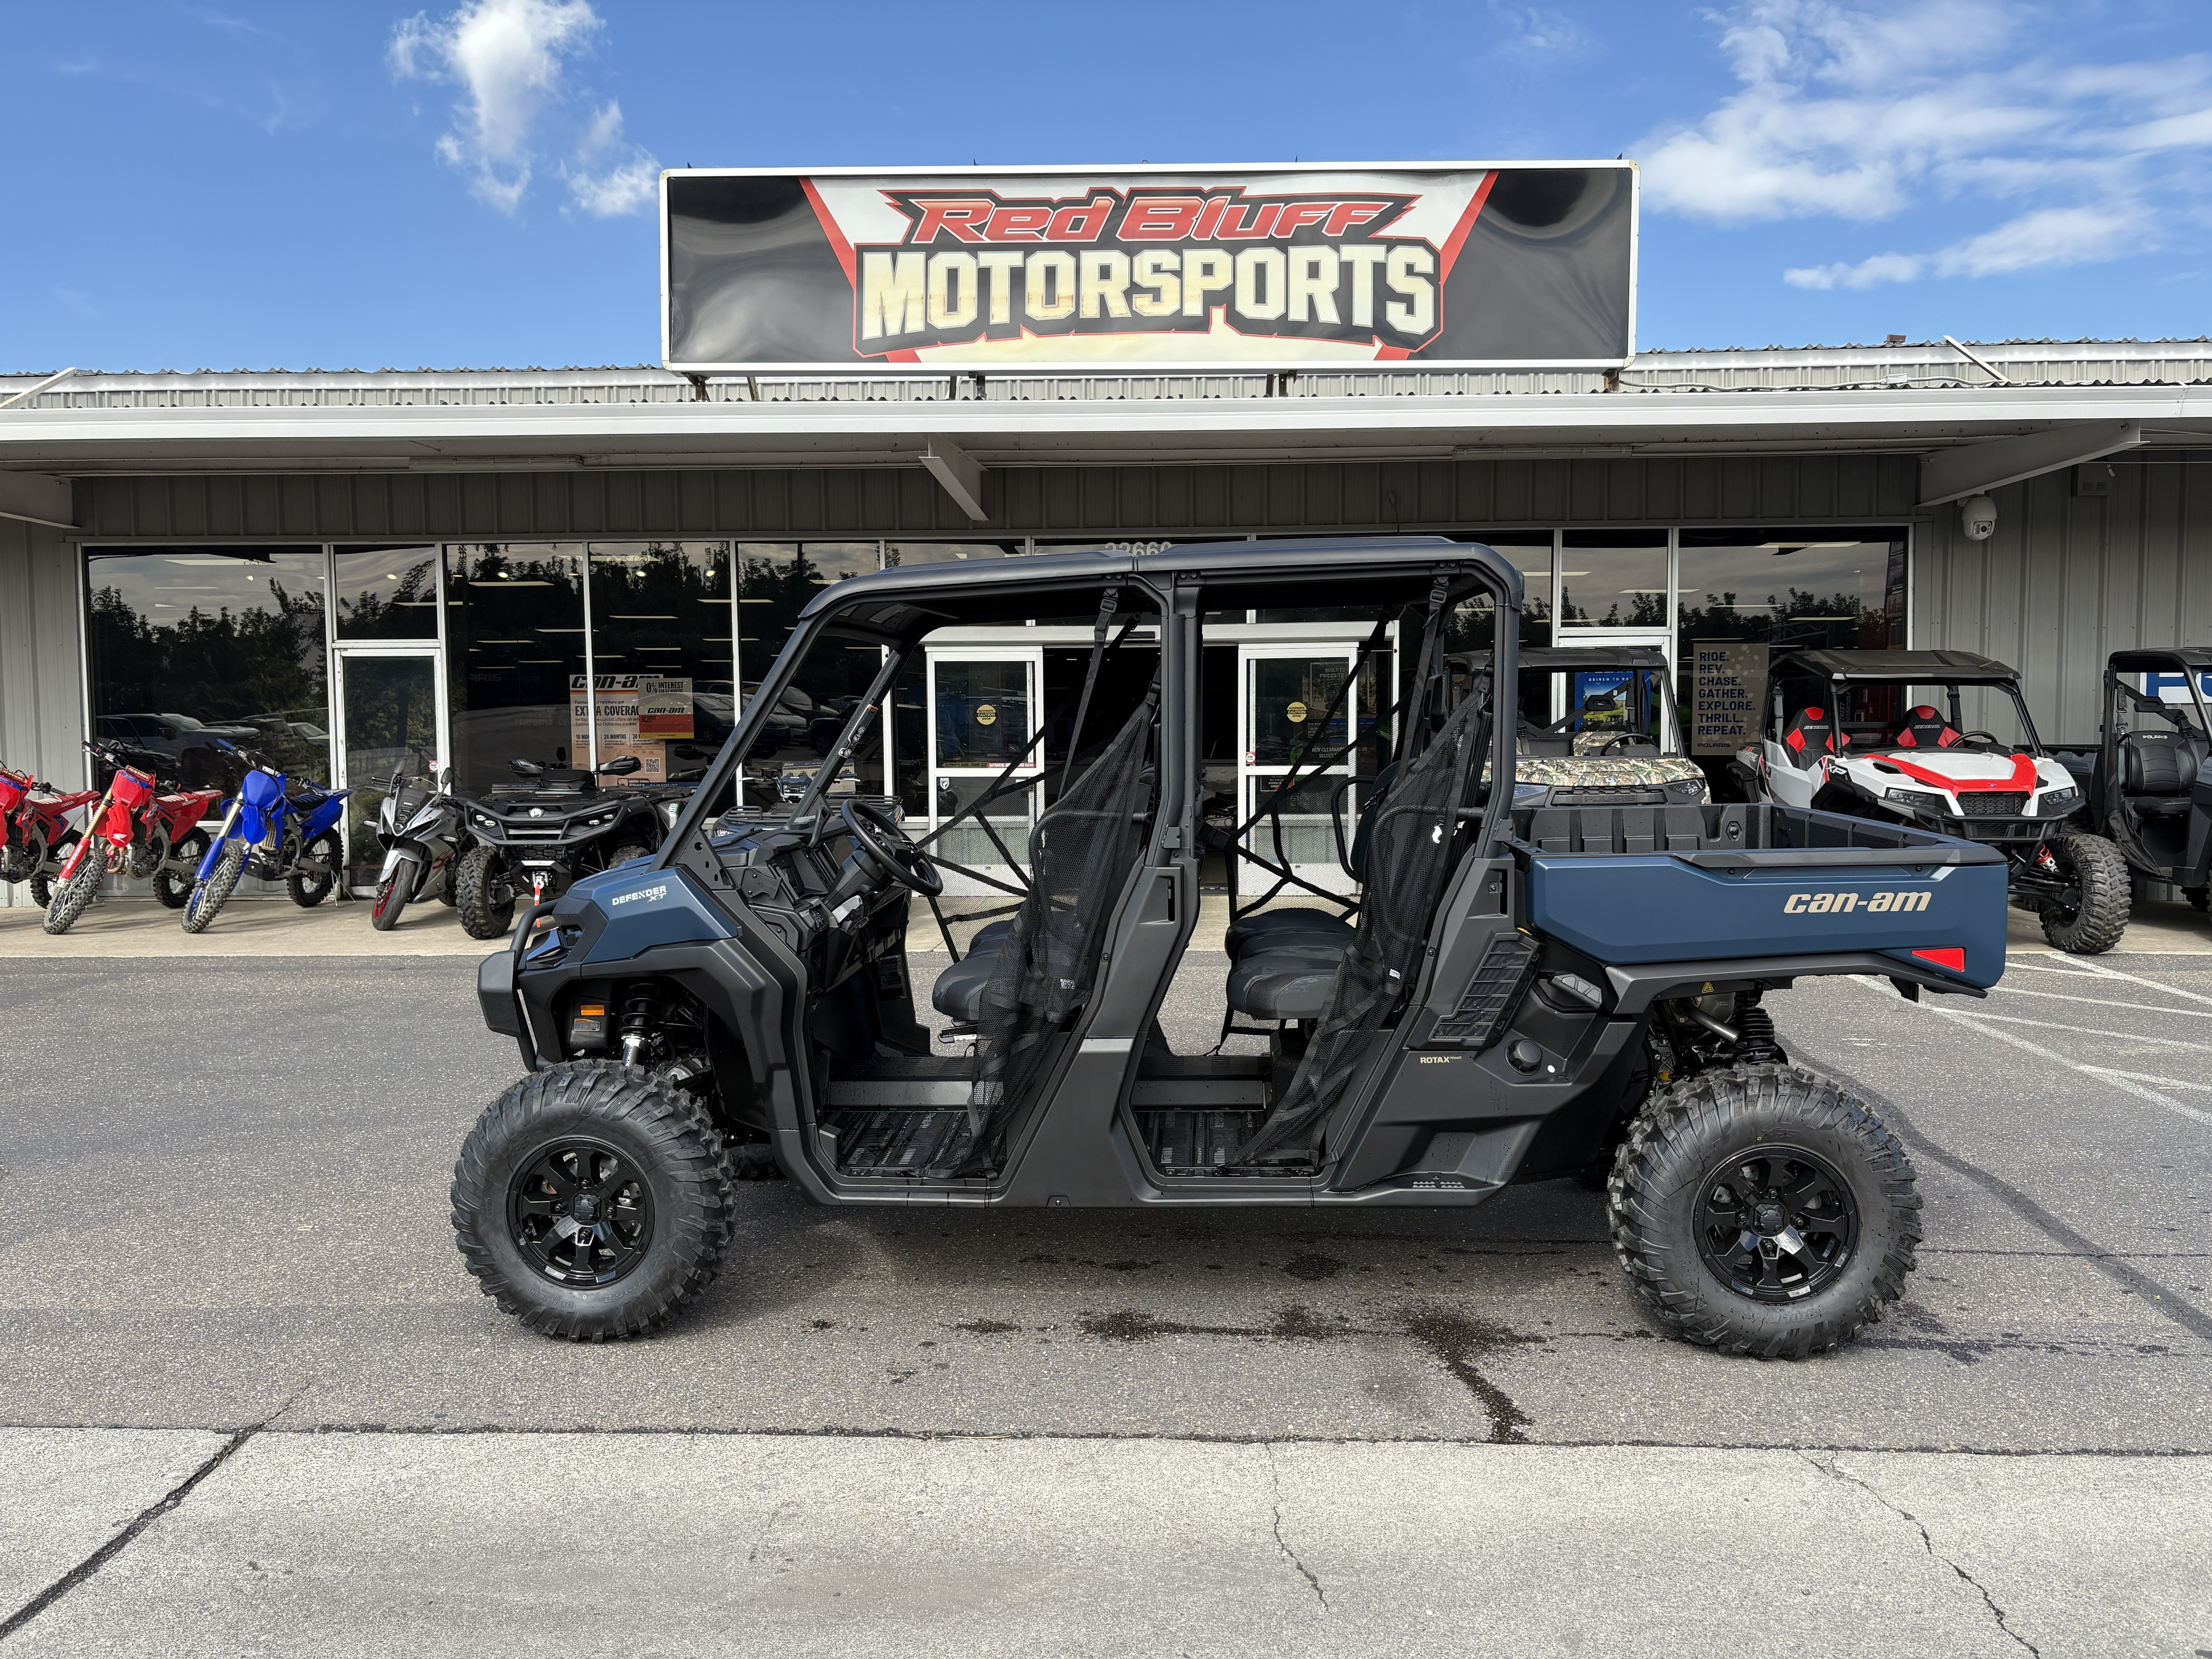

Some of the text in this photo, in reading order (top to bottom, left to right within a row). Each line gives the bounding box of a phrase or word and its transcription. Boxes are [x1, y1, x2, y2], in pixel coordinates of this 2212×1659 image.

[908, 196, 1394, 244] Red Bluff
[862, 244, 1434, 340] MOTORSPORTS
[1700, 652, 1729, 661] RIDE.
[1699, 665, 1725, 673] REV.
[571, 675, 660, 689] cn-a
[1699, 677, 1741, 686] CHASE.
[646, 682, 657, 693] 0%
[1699, 689, 1748, 698] GATHER.
[1699, 701, 1756, 710] EXPLORE.
[575, 706, 601, 716] EXTA
[1698, 714, 1743, 723] THRILL.
[1698, 726, 1746, 735] REPEAT.
[1826, 763, 1847, 775] XP
[612, 885, 666, 906] DEFENDER
[1783, 891, 1932, 914] can-am
